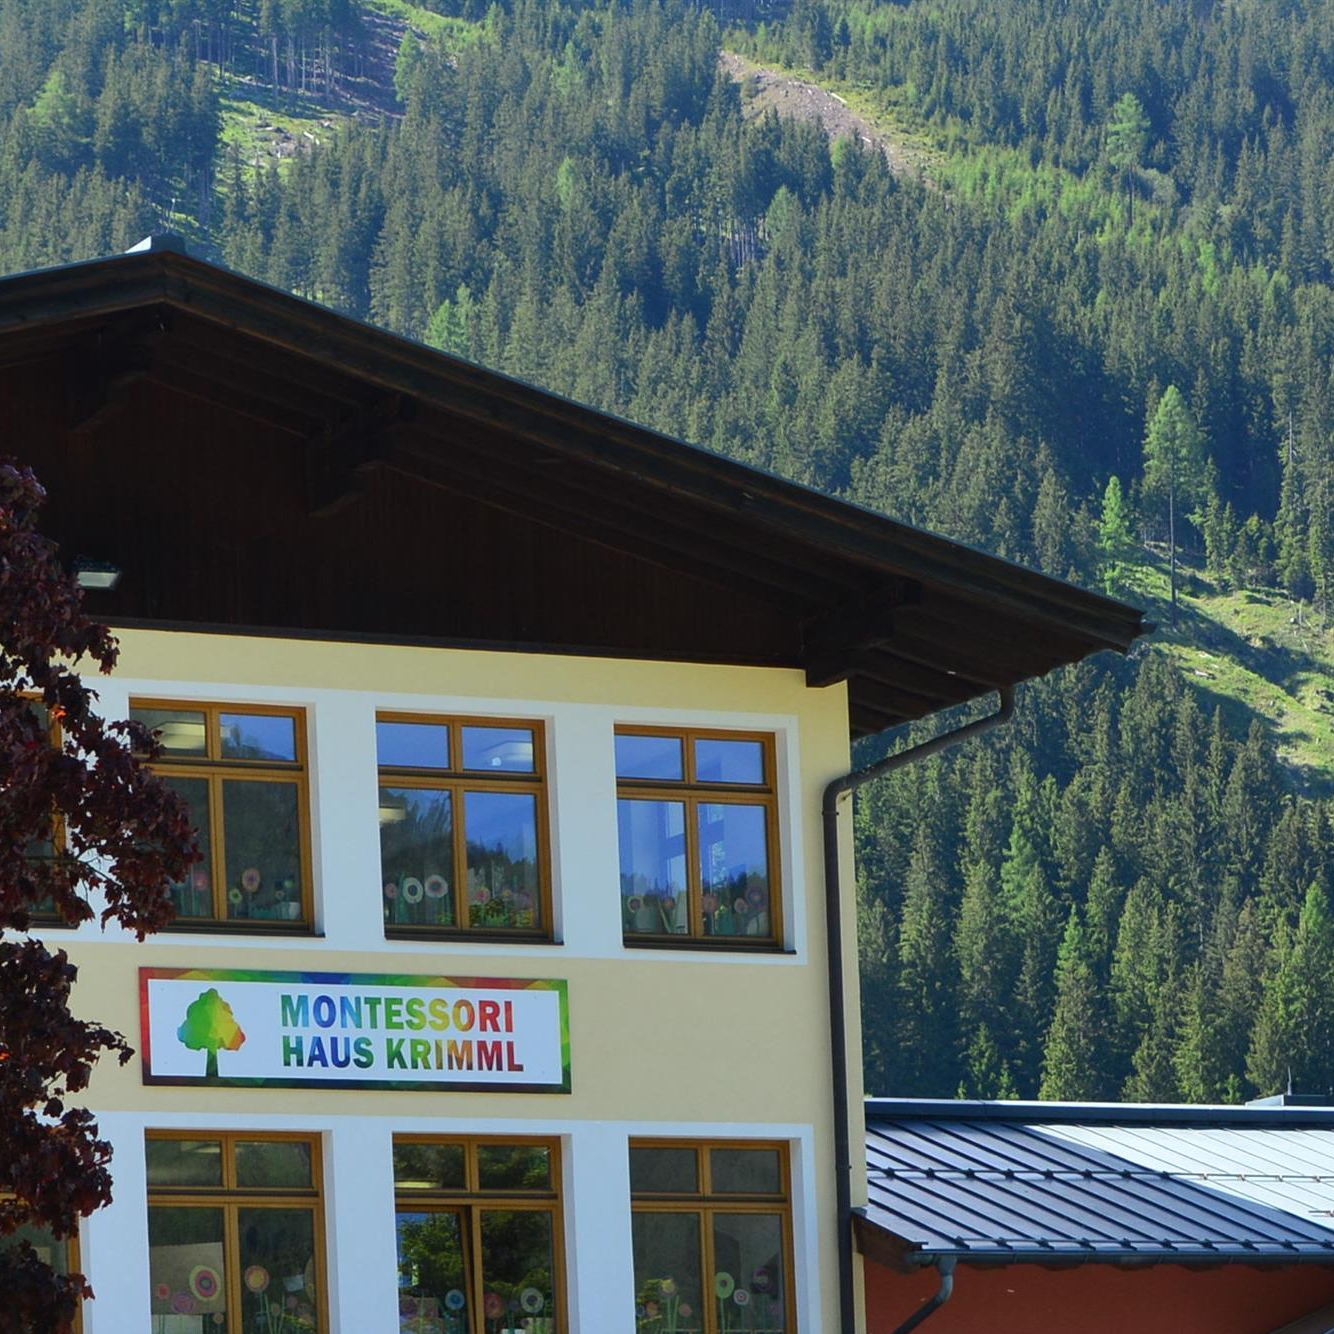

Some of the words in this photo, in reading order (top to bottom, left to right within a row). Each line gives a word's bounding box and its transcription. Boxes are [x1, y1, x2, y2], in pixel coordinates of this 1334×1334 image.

[280, 993, 513, 1033] MONTESSORI
[282, 1035, 374, 1069] HAUS
[386, 1038, 524, 1072] KRIMML
